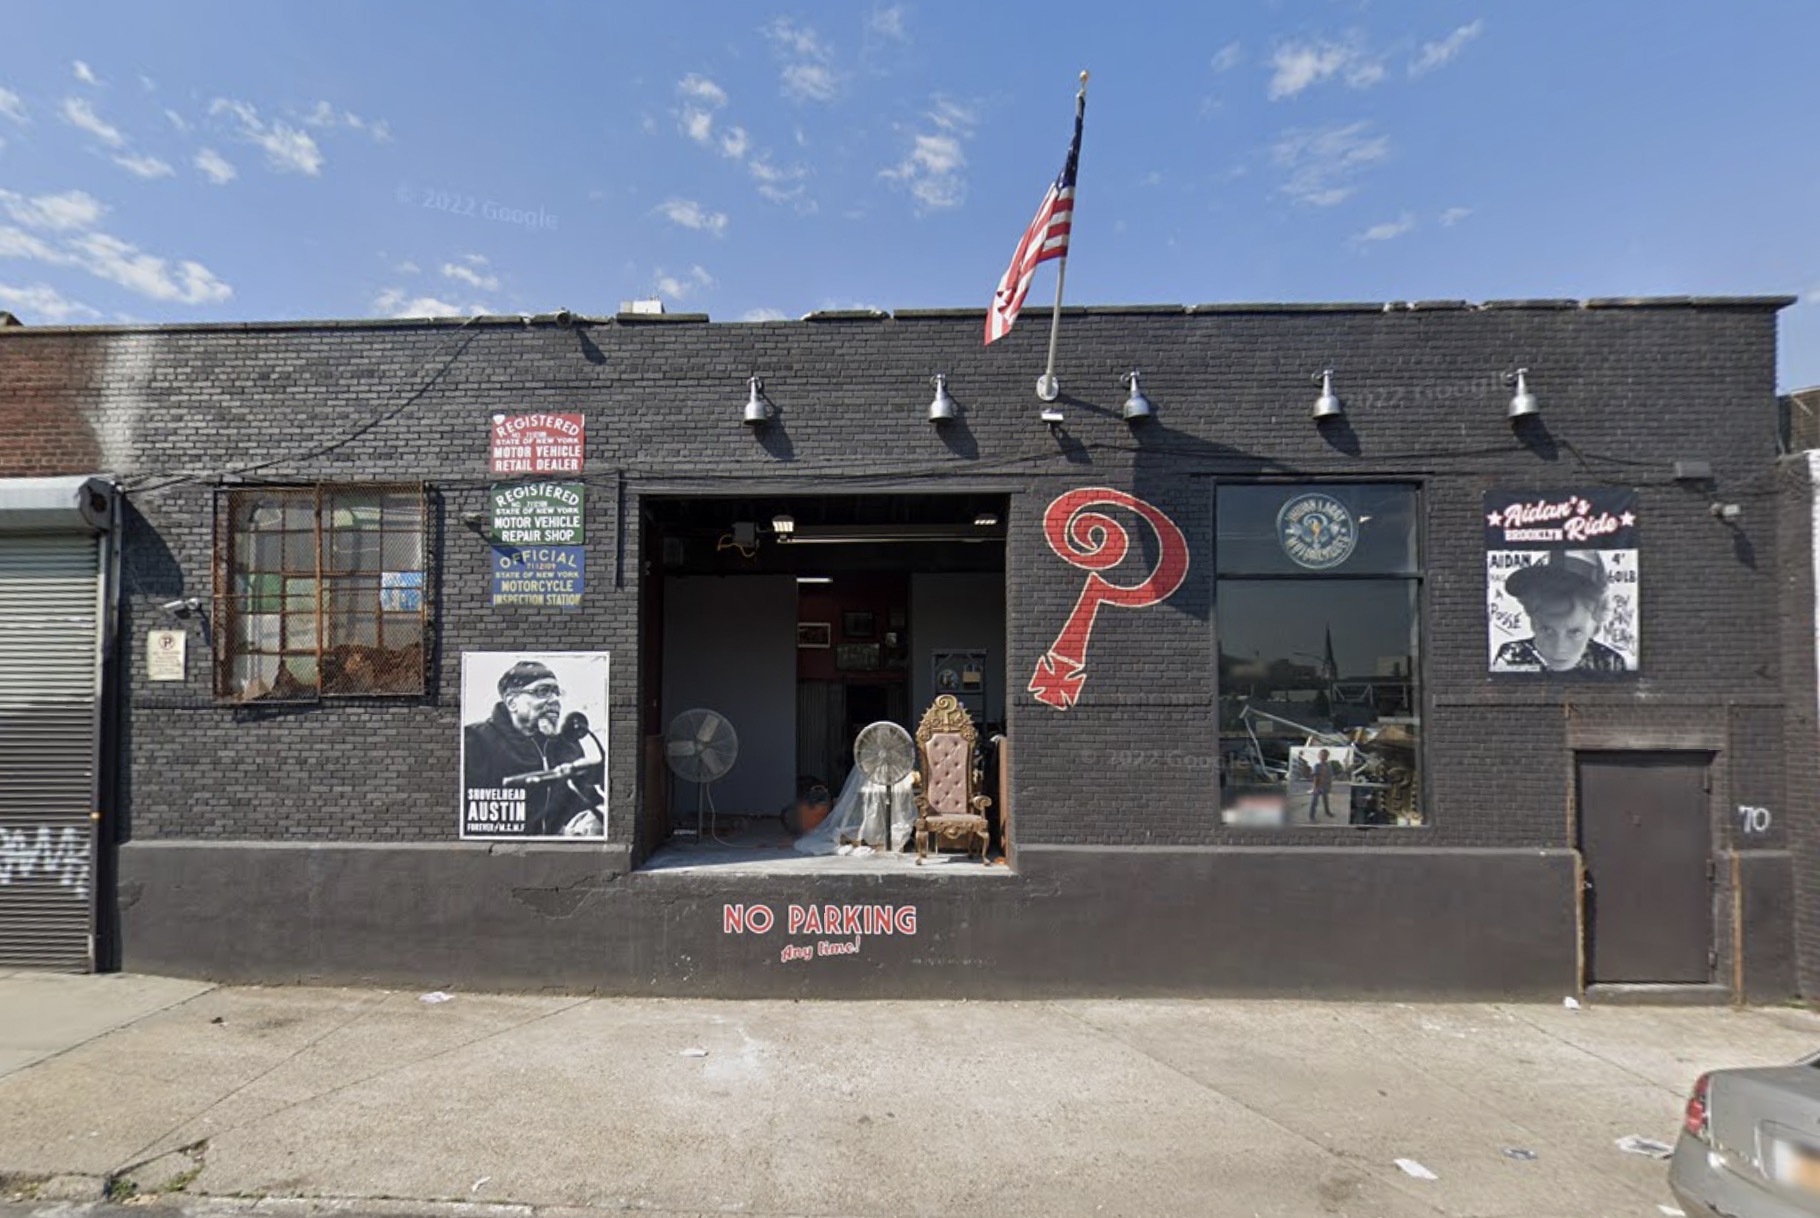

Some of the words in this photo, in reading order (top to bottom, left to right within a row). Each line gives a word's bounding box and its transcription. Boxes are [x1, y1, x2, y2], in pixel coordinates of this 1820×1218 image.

[496, 414, 580, 438] REGISTERED
[494, 446, 531, 458] MOTOR
[536, 445, 581, 457] VEHICLE
[495, 460, 532, 471] RETAIL
[537, 459, 578, 470] DEALER
[495, 483, 579, 508] REGISTERED
[494, 516, 531, 528] MOTOR
[534, 515, 580, 527] VEHICLE
[1503, 495, 1591, 528] Aidan's
[1563, 512, 1618, 541] Ride
[502, 530, 541, 542] REPAIR
[544, 530, 575, 541] SHOP
[500, 549, 577, 569] OFFICIAL
[1489, 554, 1532, 569] AIDAN
[495, 571, 520, 579] STATE
[522, 571, 534, 579] OF
[536, 571, 555, 579] NEW
[557, 571, 579, 579] YORK
[501, 580, 574, 593] MOTORCYCLE
[493, 594, 544, 606] INSPECTION
[546, 593, 582, 606] STATION
[467, 788, 527, 800] SHOVELHEAD
[467, 801, 527, 821] AUSTIN
[1738, 805, 1771, 833] 70
[723, 904, 774, 934] NO
[788, 904, 917, 935] PARKING
[781, 944, 814, 963] Any
[817, 934, 861, 957] time!
